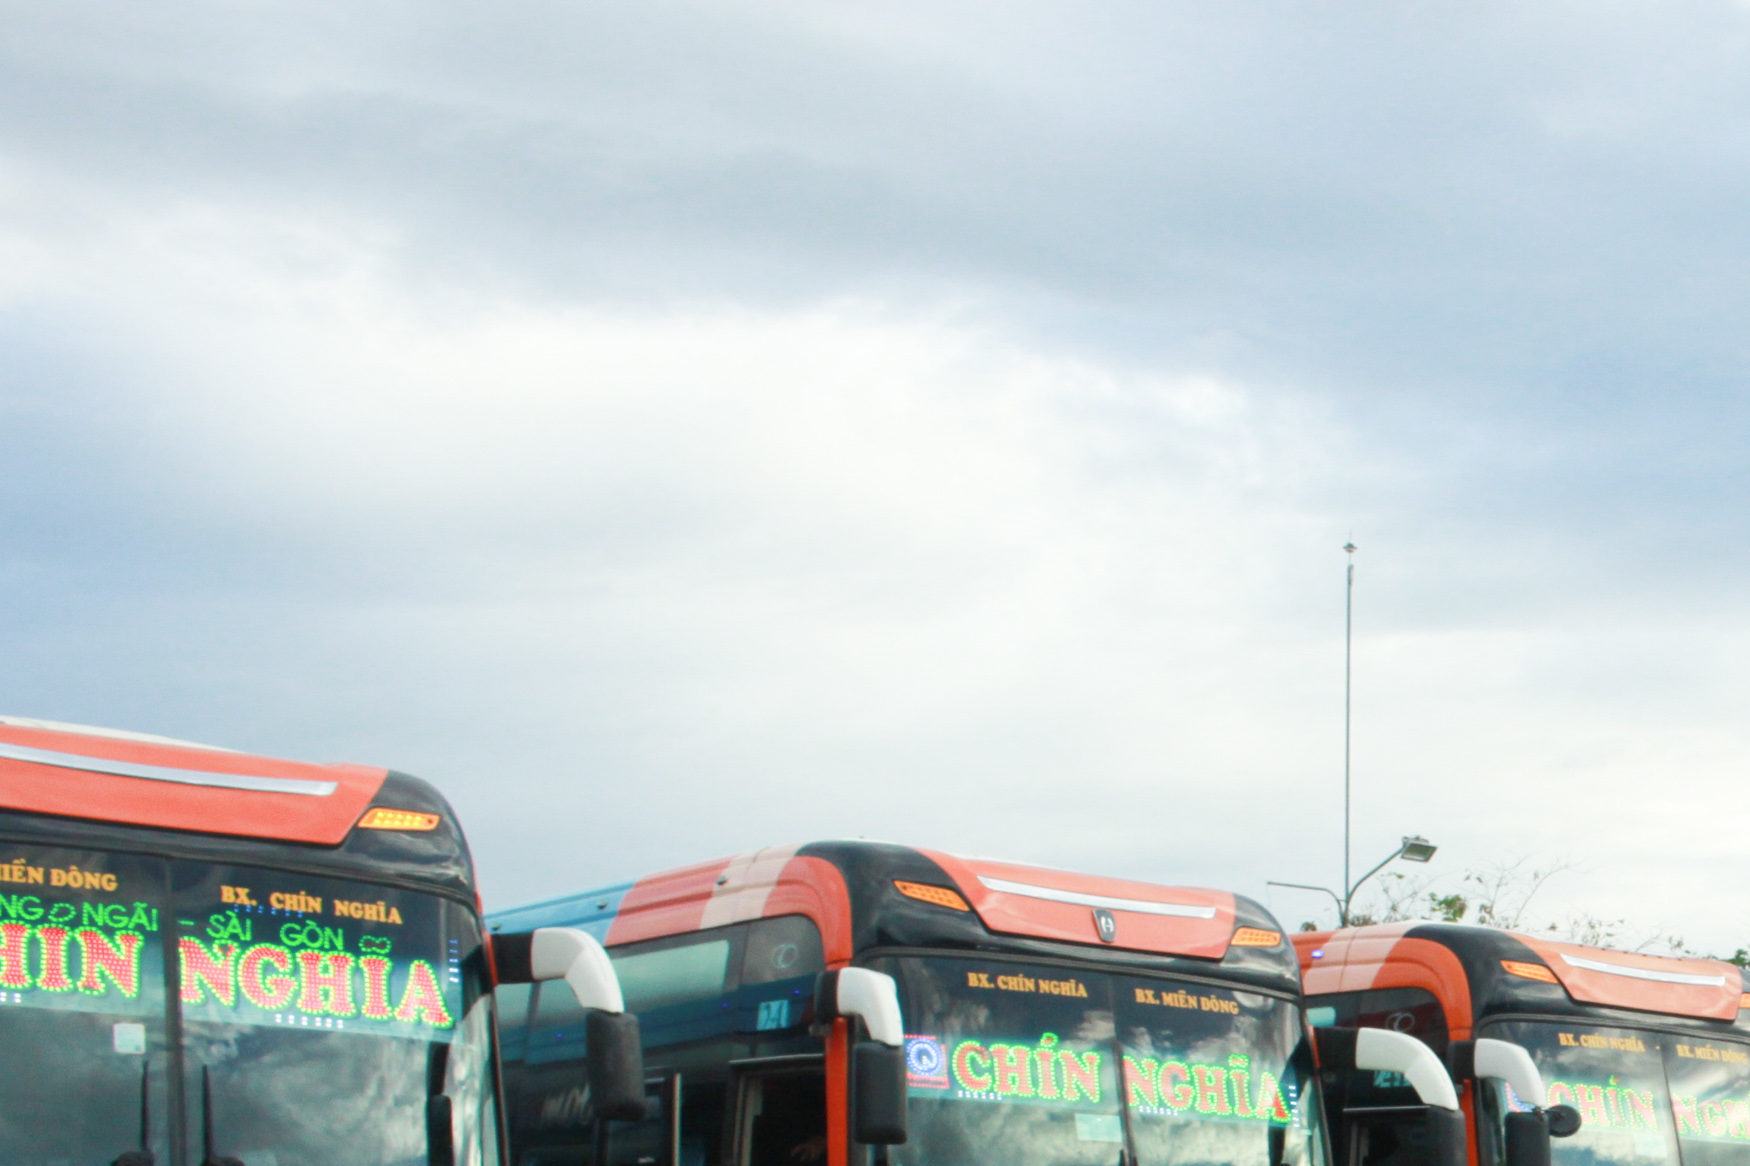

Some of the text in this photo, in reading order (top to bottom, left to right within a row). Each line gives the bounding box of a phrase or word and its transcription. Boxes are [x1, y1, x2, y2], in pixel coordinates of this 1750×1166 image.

[0, 858, 118, 891] IỀN ĐÔNG
[221, 884, 403, 925] BX. CHÍN NGHĨA
[82, 902, 158, 931] NGÃI
[206, 910, 252, 941] SÀI
[280, 920, 344, 951] GÒN
[178, 935, 454, 1029] NGHĨA
[967, 972, 1088, 998] BX. CHÍN NGHĨA
[1134, 988, 1160, 1006] BX.
[952, 1032, 1292, 1123] CHÍN NGHĨA
